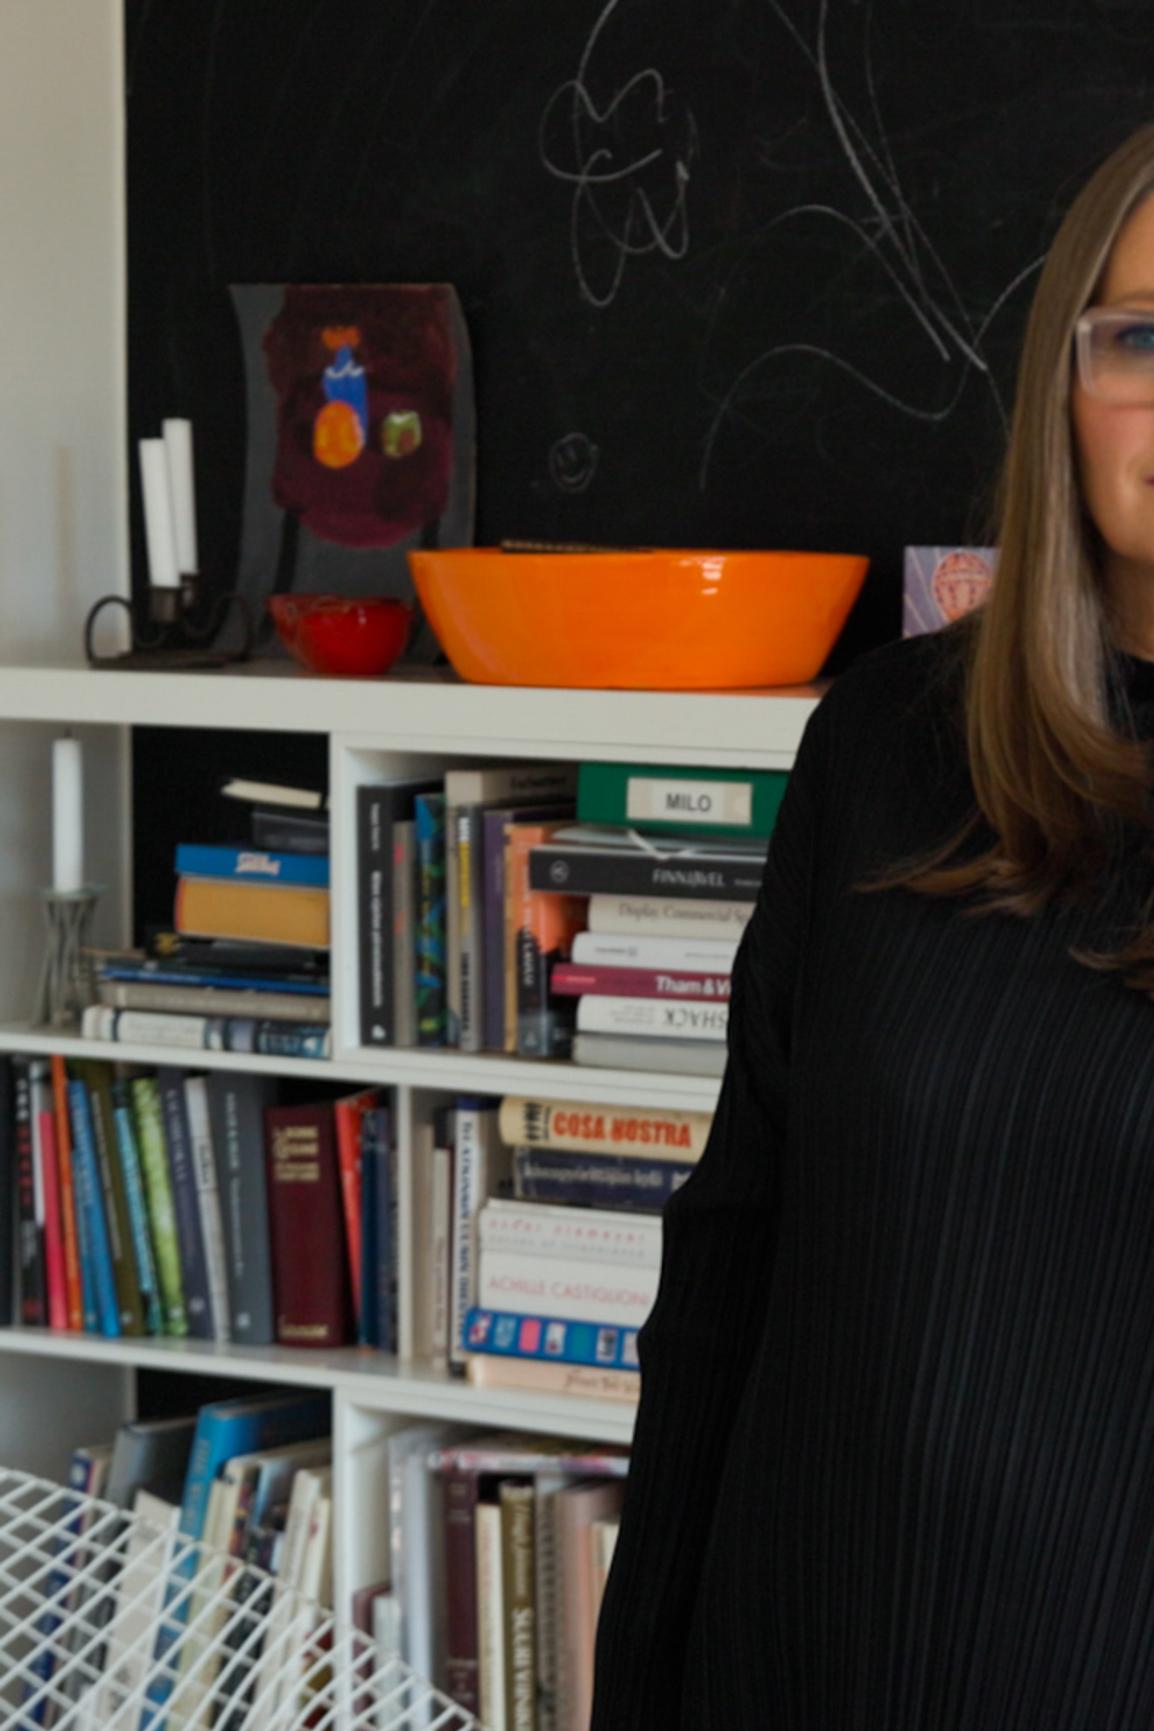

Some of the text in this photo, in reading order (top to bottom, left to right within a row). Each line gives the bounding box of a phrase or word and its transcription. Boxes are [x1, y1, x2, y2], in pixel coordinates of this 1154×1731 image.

[665, 793, 712, 812] MILO
[553, 1111, 605, 1140] COSA
[611, 1116, 692, 1148] NOSTRA
